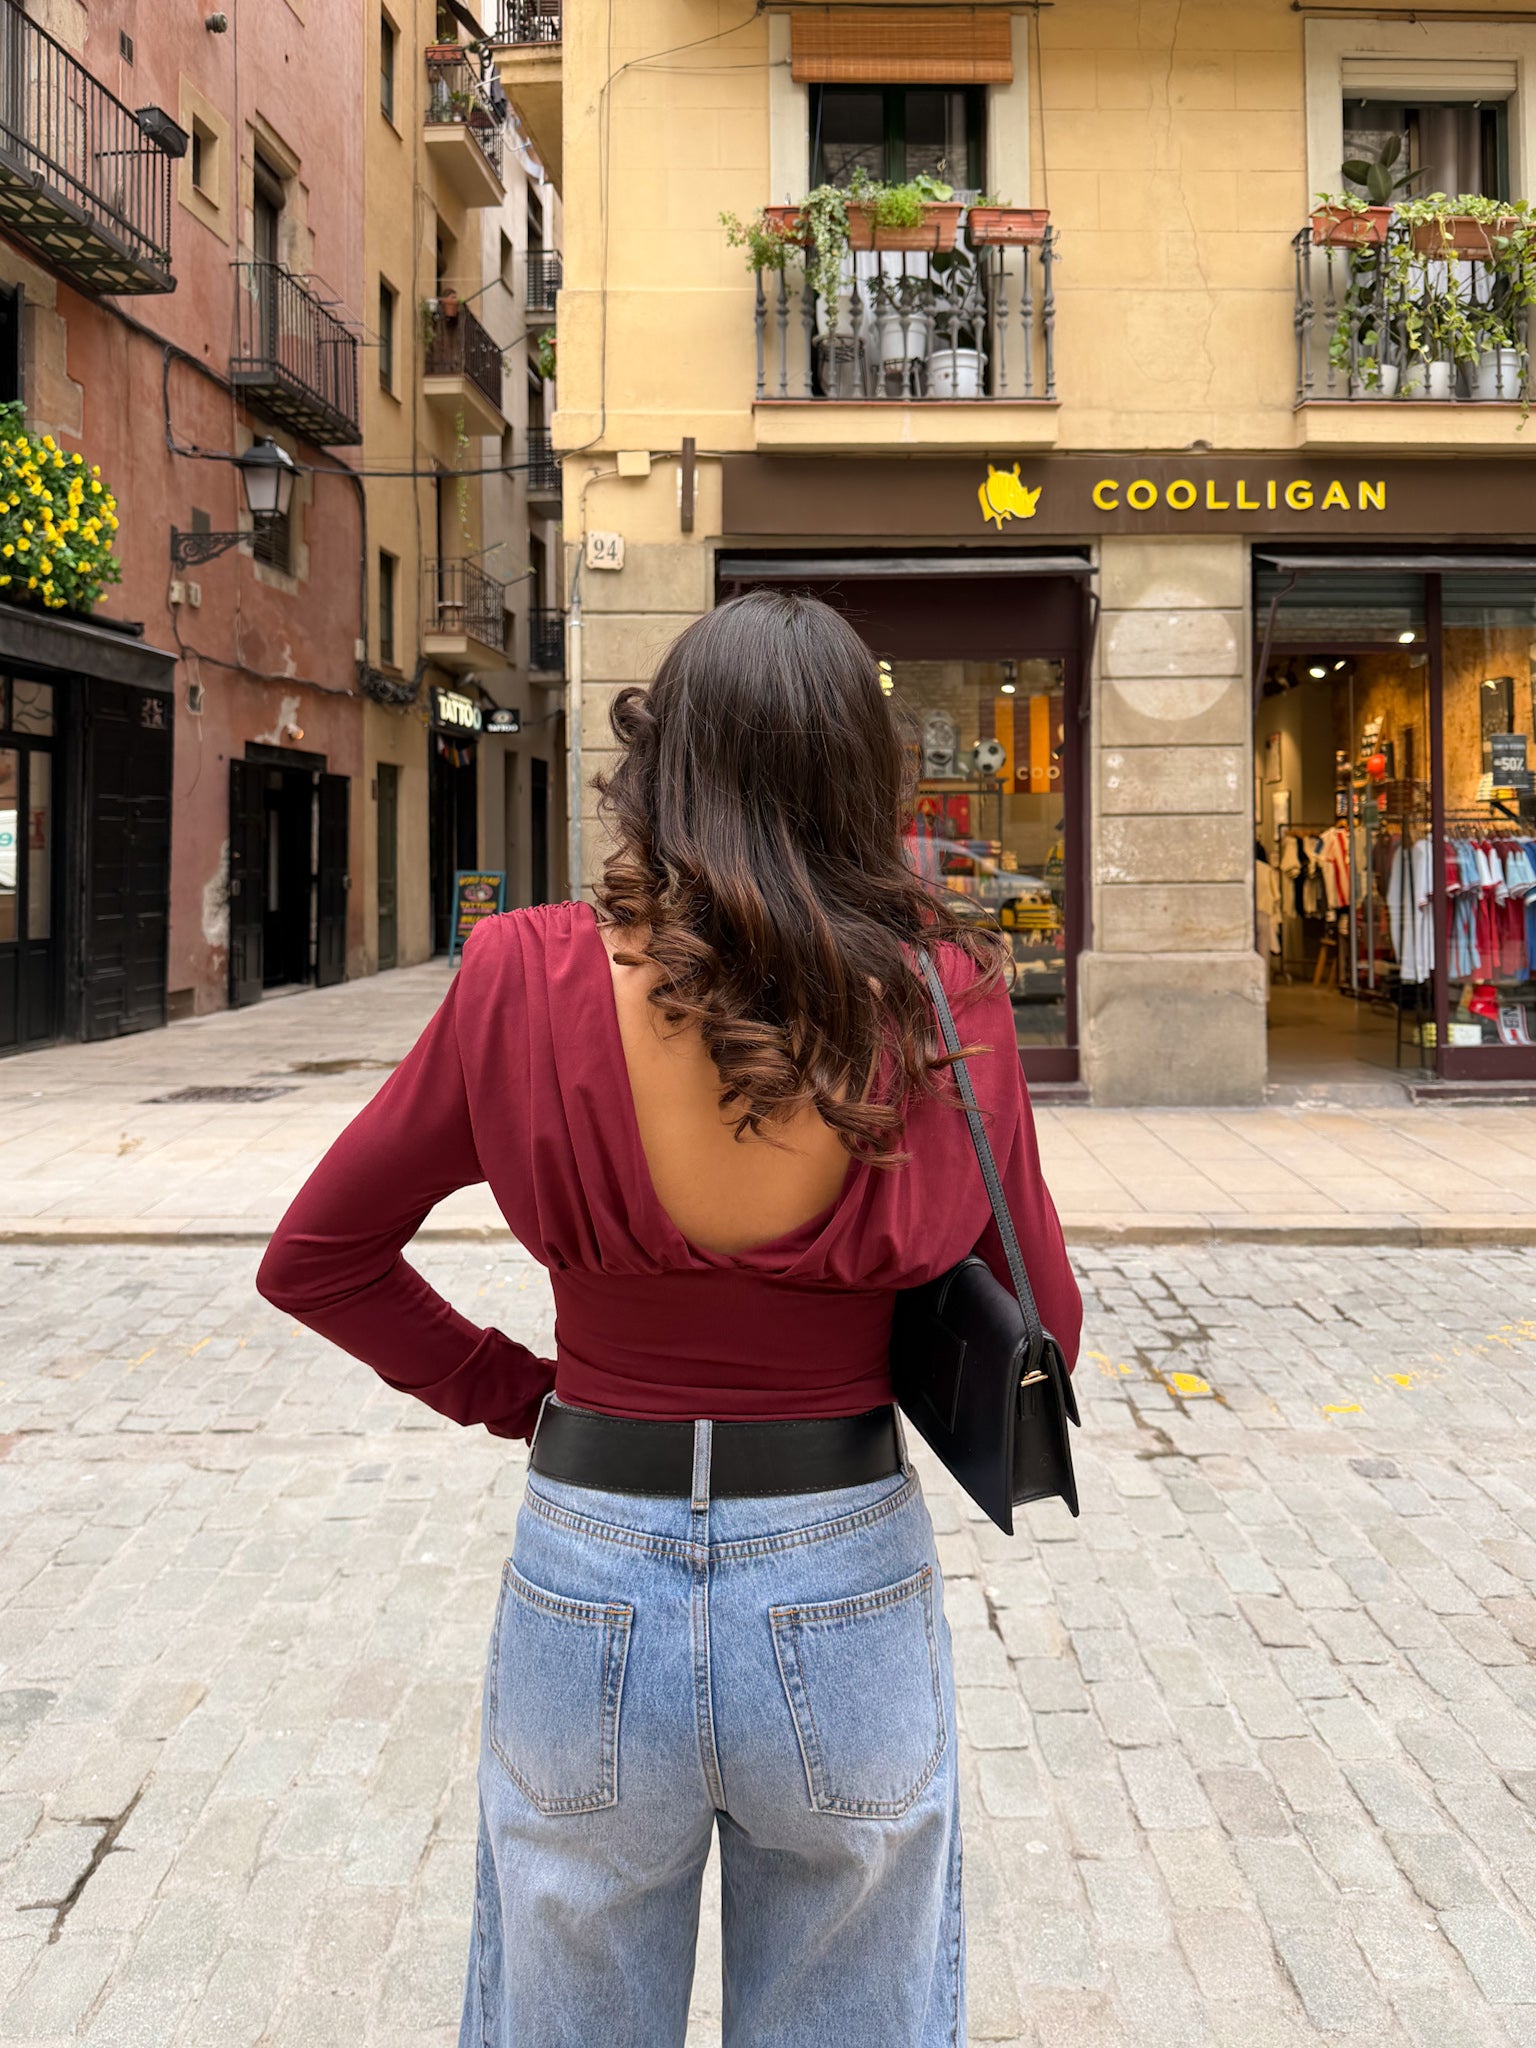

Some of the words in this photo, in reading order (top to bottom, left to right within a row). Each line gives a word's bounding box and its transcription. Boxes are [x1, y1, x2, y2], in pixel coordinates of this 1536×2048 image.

[1092, 479, 1387, 511] COOLLIGAN
[593, 539, 619, 561] 24
[438, 694, 482, 730] TATTOO
